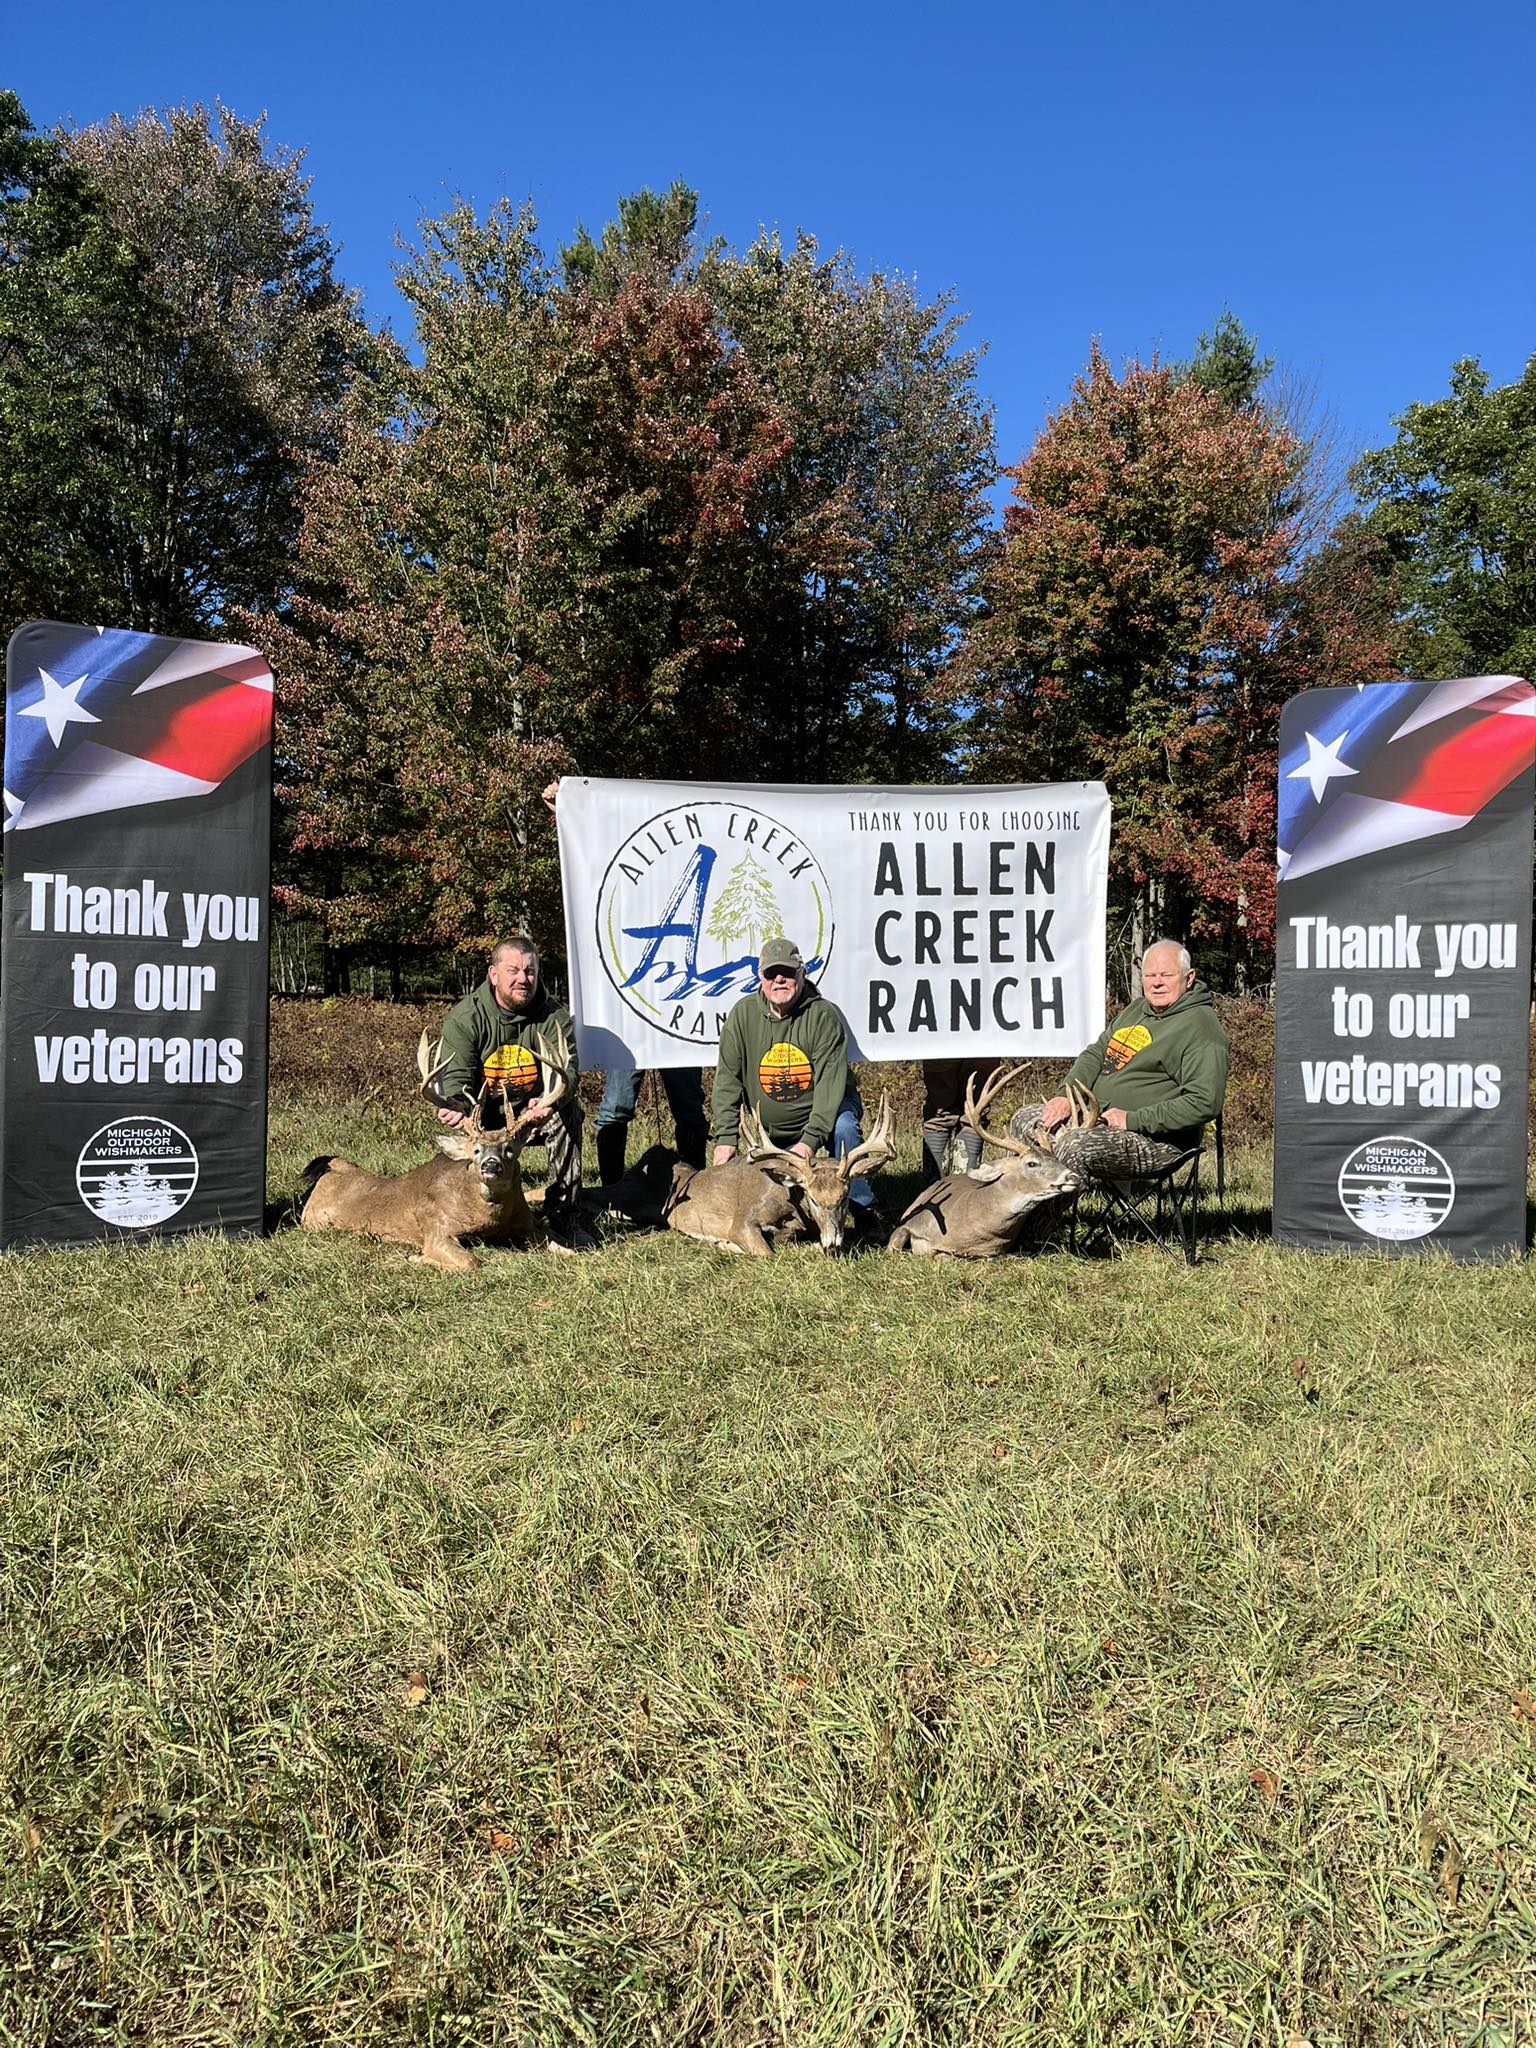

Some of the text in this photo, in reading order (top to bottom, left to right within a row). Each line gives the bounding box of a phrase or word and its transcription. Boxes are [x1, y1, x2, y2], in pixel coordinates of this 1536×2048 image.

[848, 811, 1081, 832] THANK YOU FOR CHOOSING
[619, 813, 814, 886] ALLEN CREEK
[874, 842, 1056, 896] ALLEN
[23, 872, 260, 948] Thank you
[874, 909, 1056, 966] CREEK
[1289, 915, 1518, 978] Thank you
[71, 953, 216, 1011] to our
[868, 976, 1065, 1034] RANCH
[669, 1004, 727, 1037] RAN
[1331, 986, 1470, 1039] to our
[33, 1028, 244, 1085] veterans
[1300, 1055, 1502, 1110] veterans
[95, 1146, 182, 1156] WISHMAKERS
[107, 1128, 171, 1138] MICHIGAN
[107, 1137, 171, 1147] OUTDOOR
[1365, 1147, 1427, 1158] MICHIGAN
[1354, 1163, 1438, 1175] WISHMAKERS
[1365, 1156, 1426, 1166] OUTDOOR
